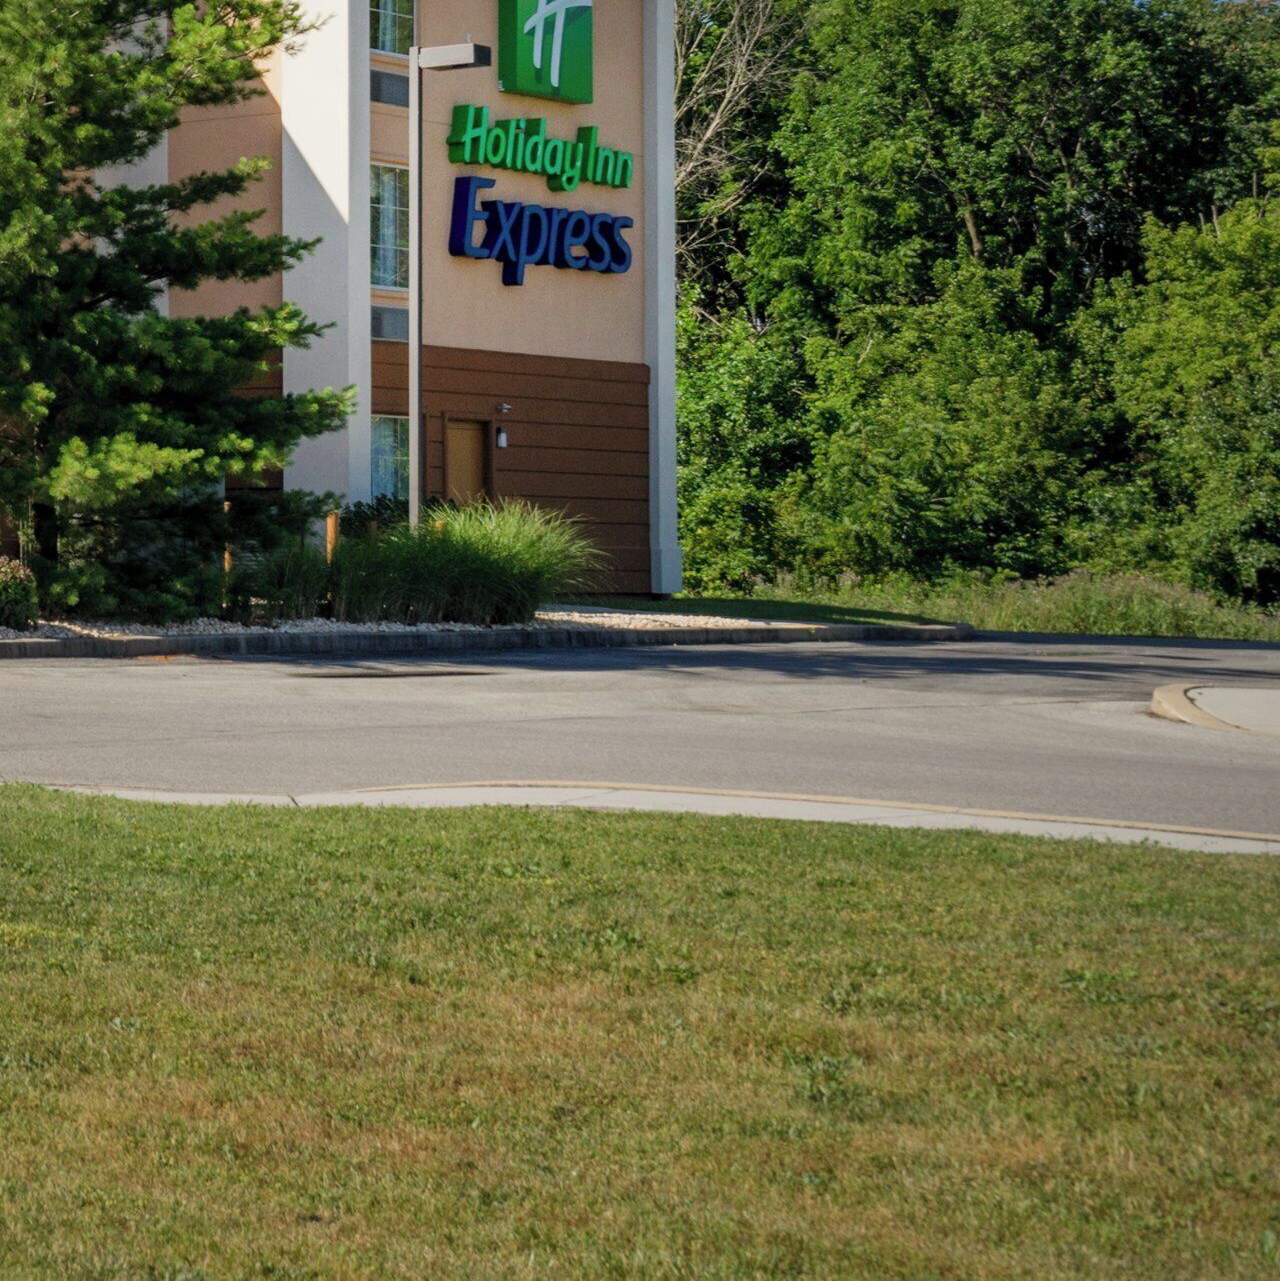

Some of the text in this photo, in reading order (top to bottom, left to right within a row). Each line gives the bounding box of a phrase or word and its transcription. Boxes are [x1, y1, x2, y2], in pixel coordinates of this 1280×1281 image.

[455, 104, 634, 192] Holiday Inn
[455, 175, 634, 287] Express
